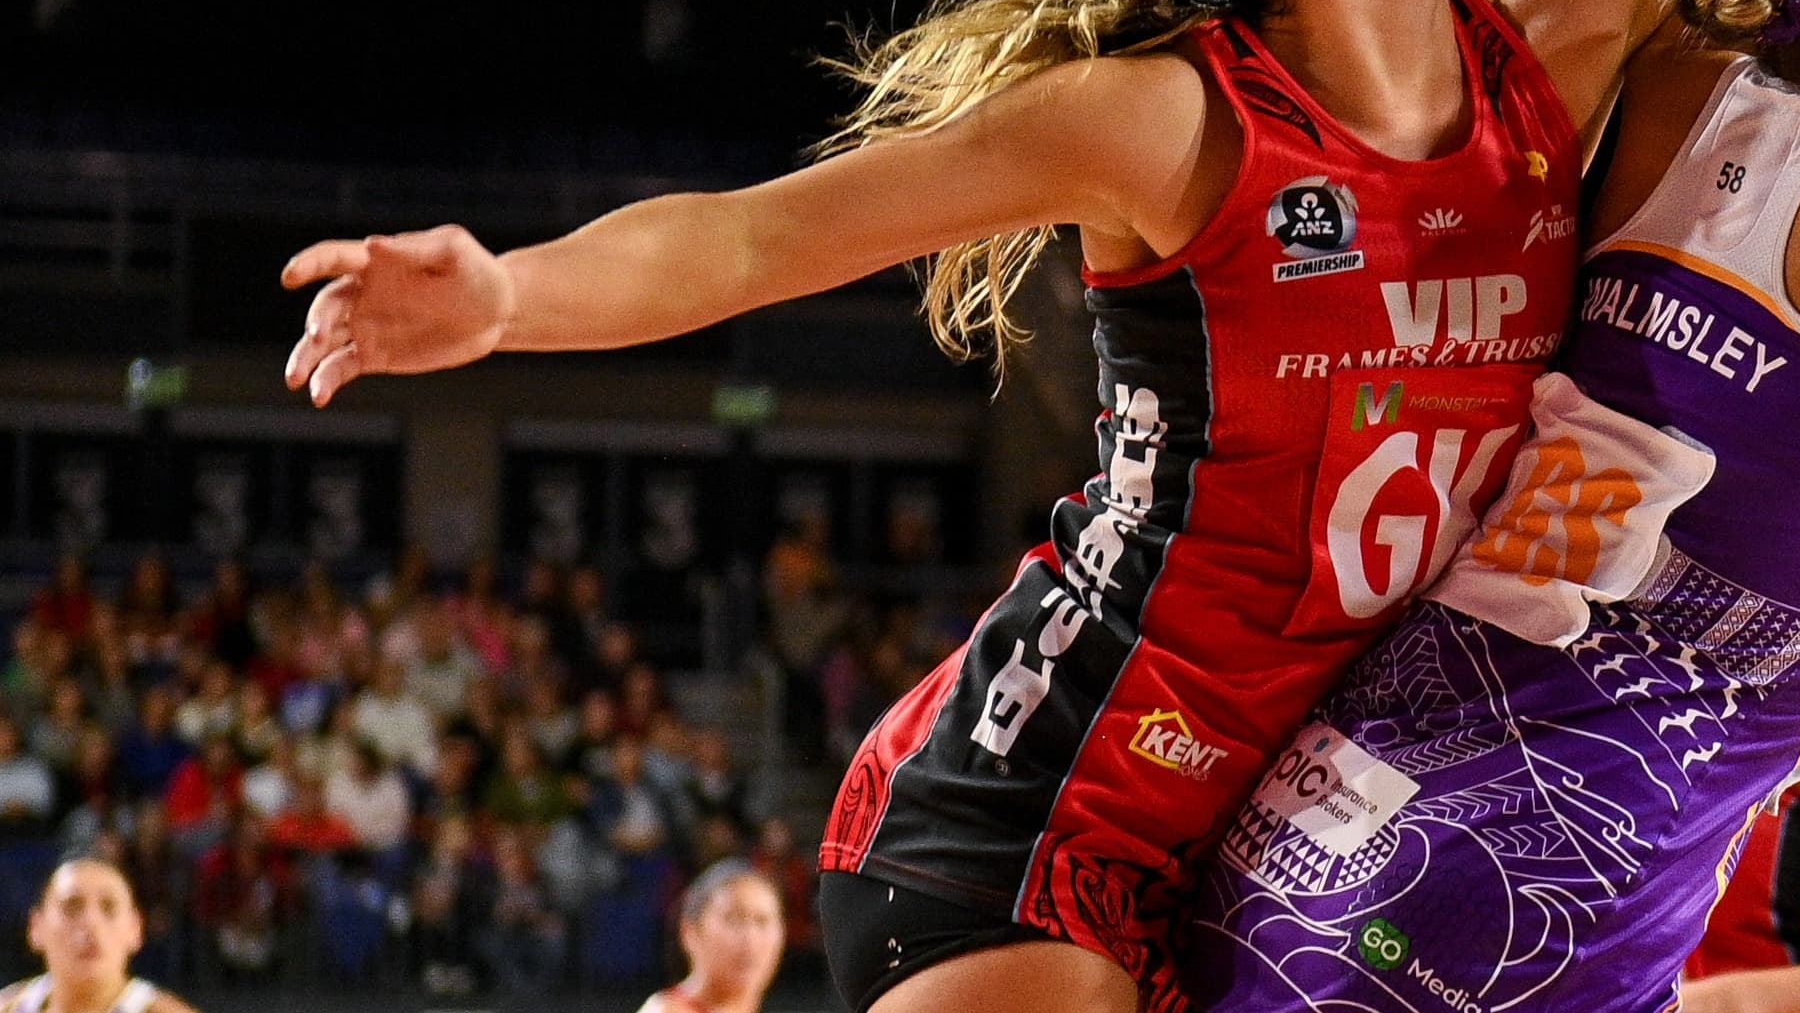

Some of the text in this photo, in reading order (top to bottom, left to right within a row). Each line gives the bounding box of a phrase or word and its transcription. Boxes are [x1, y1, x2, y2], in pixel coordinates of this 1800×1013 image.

[1716, 161, 1746, 194] 58
[1290, 220, 1335, 237] ANZ
[1277, 253, 1361, 280] PREMIERSHIP
[1380, 274, 1527, 348] VIP
[1434, 338, 1457, 368] &
[1464, 332, 1563, 364] TRUSS
[1581, 277, 1788, 394] WALMSLEY
[1141, 724, 1228, 771] KENT
[1315, 794, 1353, 824] Brokers
[1363, 927, 1482, 1013] GO Media
